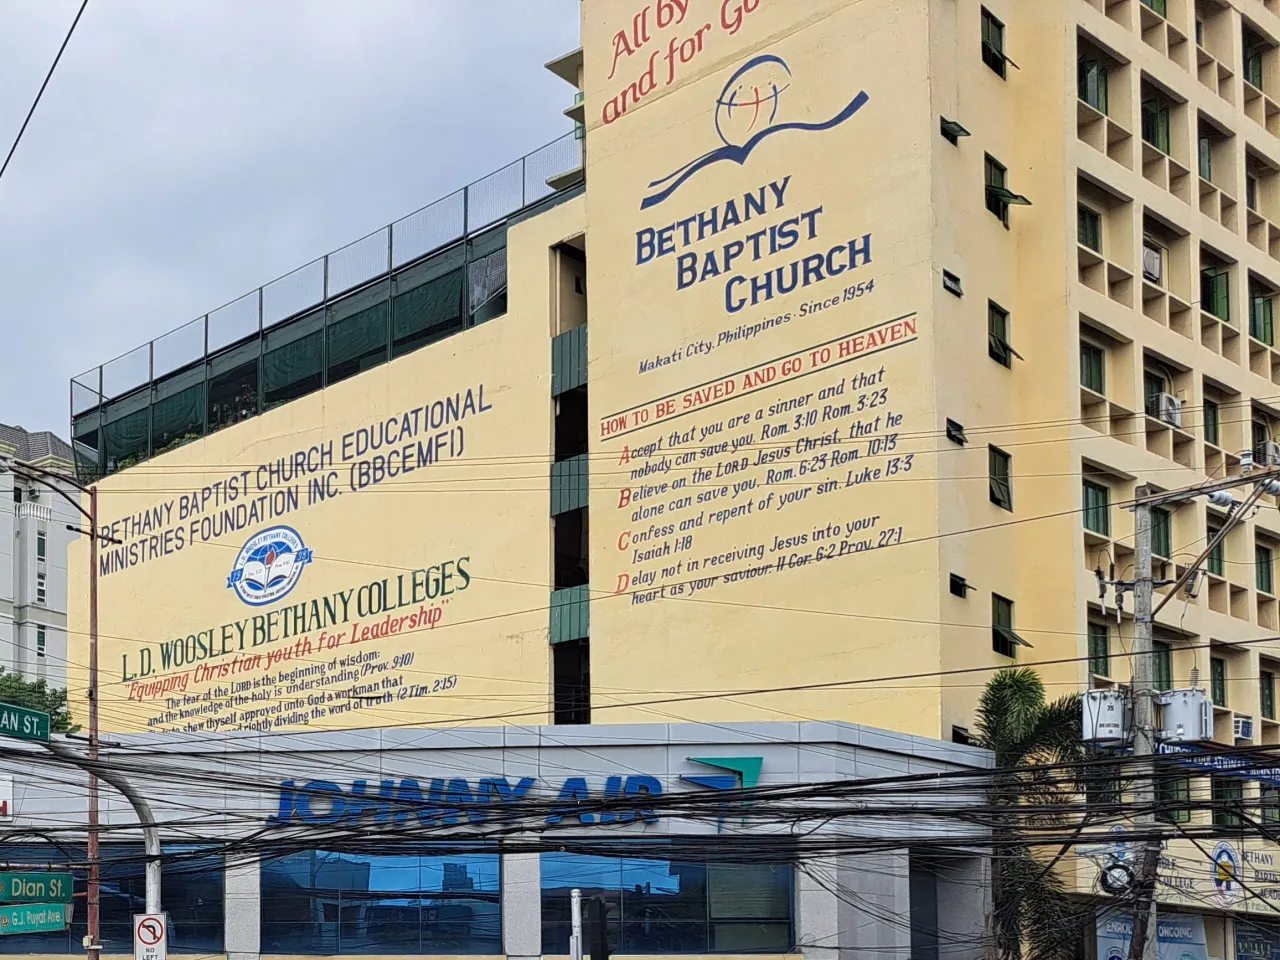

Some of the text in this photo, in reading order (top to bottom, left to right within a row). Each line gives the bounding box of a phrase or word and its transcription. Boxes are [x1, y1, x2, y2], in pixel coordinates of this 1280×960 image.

[602, 51, 659, 124] and
[664, 23, 711, 85] for
[608, 0, 689, 79] All by
[636, 175, 791, 266] BETHANY
[676, 205, 823, 291] BAPTIST
[725, 233, 872, 313] CHURCH
[638, 349, 682, 374] Makati
[717, 312, 791, 347] Philippines
[799, 294, 840, 317] Since
[843, 279, 875, 302] 1954
[600, 318, 917, 437] HOW TO BE SAVED AND GO TO HEAVEN
[618, 365, 886, 466] Accept that you are a sinner and that
[100, 384, 493, 549] BETHANY BAPTIST CHURCH EDUCATIONAL
[618, 482, 668, 509] Believe
[671, 477, 686, 490] on
[692, 468, 712, 484] the
[715, 457, 749, 479] LORD
[753, 446, 791, 467] Jesus
[849, 416, 881, 439] that
[886, 411, 903, 429] he
[630, 388, 888, 480] nobody can save you. Rom. 3:10 Rom. 3:23
[100, 526, 185, 577] MINISTRIES
[189, 484, 298, 546] FOUNDATION
[308, 471, 342, 506] INC.
[350, 425, 464, 491] (BBCEMFI)
[617, 454, 914, 551] Confess and repent of your sin. Luke 13:3
[632, 535, 693, 564] Isaiah 1:18
[160, 619, 249, 672] WOOSLEY
[251, 589, 355, 647] BETHANY
[357, 556, 471, 618] COLLEGES
[193, 654, 261, 684] Christian
[264, 635, 312, 671] youth
[318, 631, 346, 653] for
[148, 713, 164, 727] and
[165, 709, 178, 722] the
[180, 701, 223, 719] knowledge
[225, 696, 234, 709] of
[234, 695, 249, 706] the
[252, 689, 271, 703] holy
[274, 685, 282, 697] is
[286, 670, 360, 695] understanding
[166, 650, 381, 709] The fear of the LORD is the beginning of wisdom:
[23, 714, 40, 736] ST.
[266, 775, 663, 827] JOHNNY AIR
[11, 878, 65, 897] Dian St.
[1158, 926, 1193, 938] ONGOING
